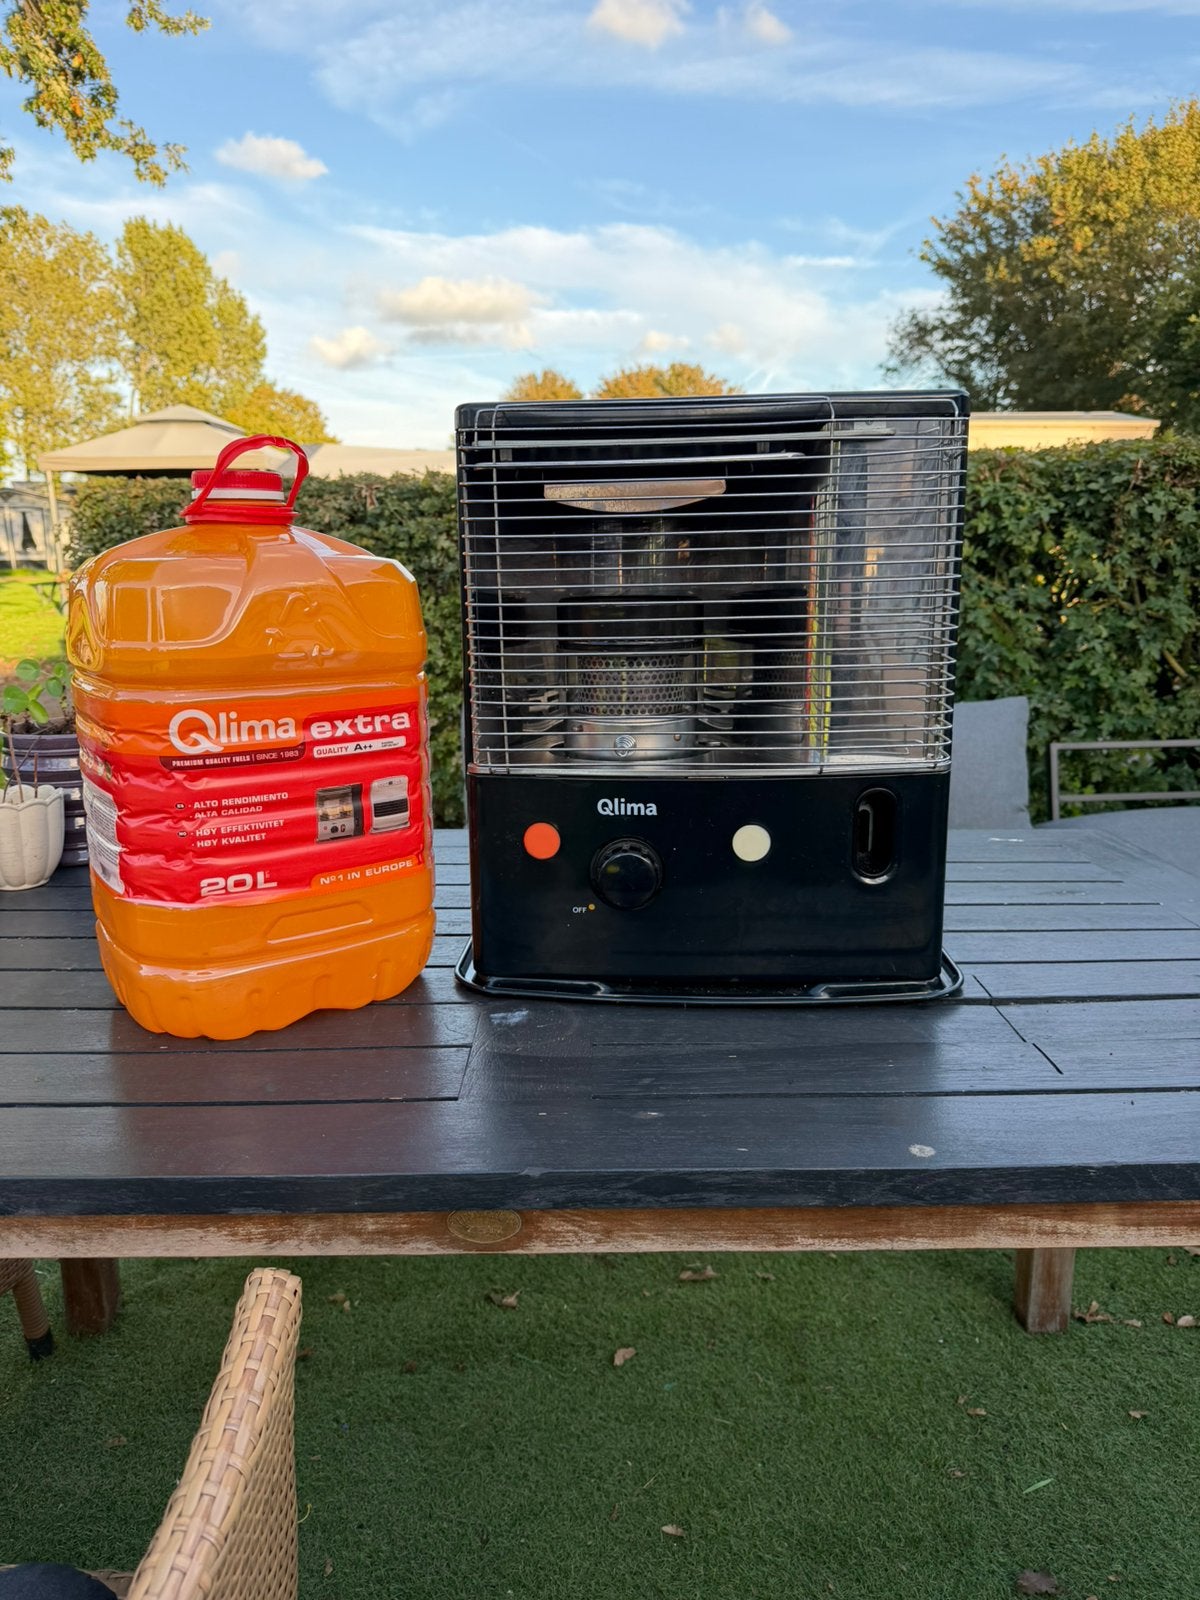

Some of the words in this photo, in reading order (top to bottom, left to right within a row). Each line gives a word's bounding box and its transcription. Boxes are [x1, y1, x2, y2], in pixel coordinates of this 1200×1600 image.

[169, 709, 297, 755] Qlima
[310, 711, 411, 740] extra
[316, 745, 350, 756] QUALITY
[353, 743, 374, 752] A++
[172, 759, 204, 767] PREMIUM
[205, 757, 231, 765] QUALITY
[232, 755, 251, 763] FUELS
[256, 752, 278, 761] SINCE
[193, 800, 219, 810] ALTO
[221, 792, 289, 807] RENDIMIENTO
[597, 798, 658, 815] Qlima
[194, 810, 218, 819] ALTA
[221, 805, 263, 816] CALIDAD
[195, 828, 218, 837] HØY
[220, 819, 285, 834] EFFEKTIVITET
[196, 839, 218, 848] HØY
[221, 832, 267, 845] KVALITET
[347, 871, 361, 881] IN
[365, 859, 413, 877] EUROPE
[572, 906, 588, 914] OFF
